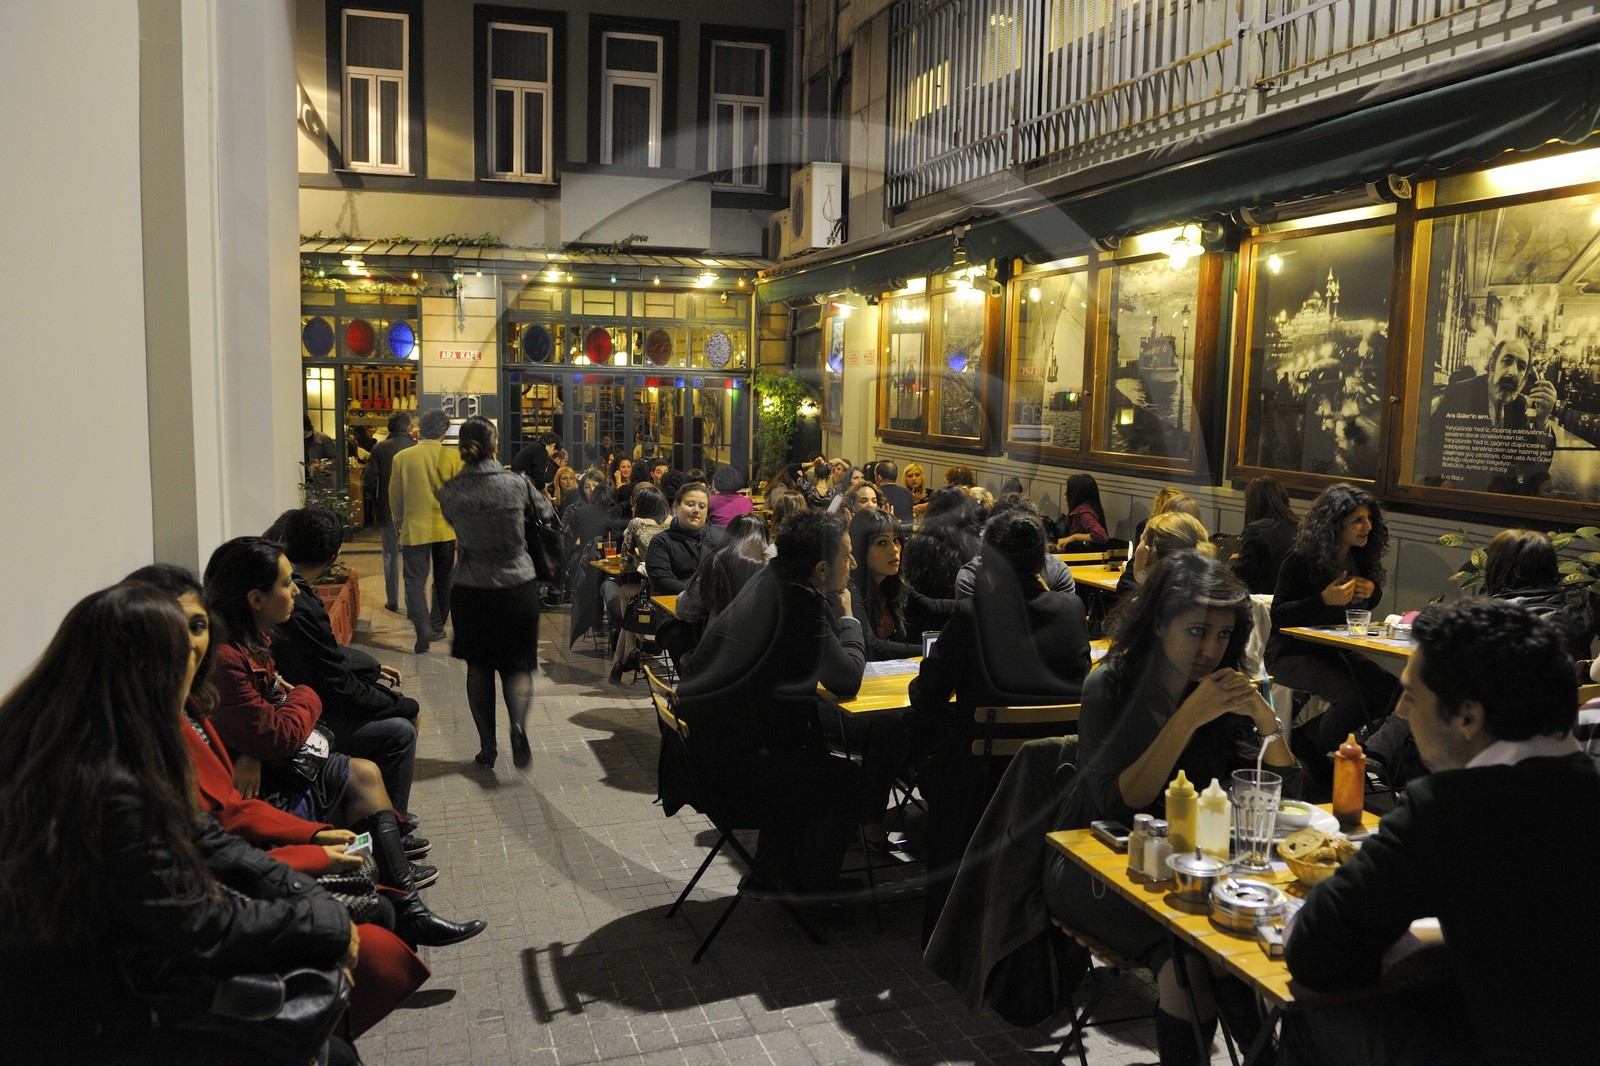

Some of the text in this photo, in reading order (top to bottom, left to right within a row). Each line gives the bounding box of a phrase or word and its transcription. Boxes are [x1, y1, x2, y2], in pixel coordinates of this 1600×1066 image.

[442, 351, 480, 361] ARA KAFE
[441, 393, 479, 418] ara
[1456, 412, 1477, 420] Güler'in
